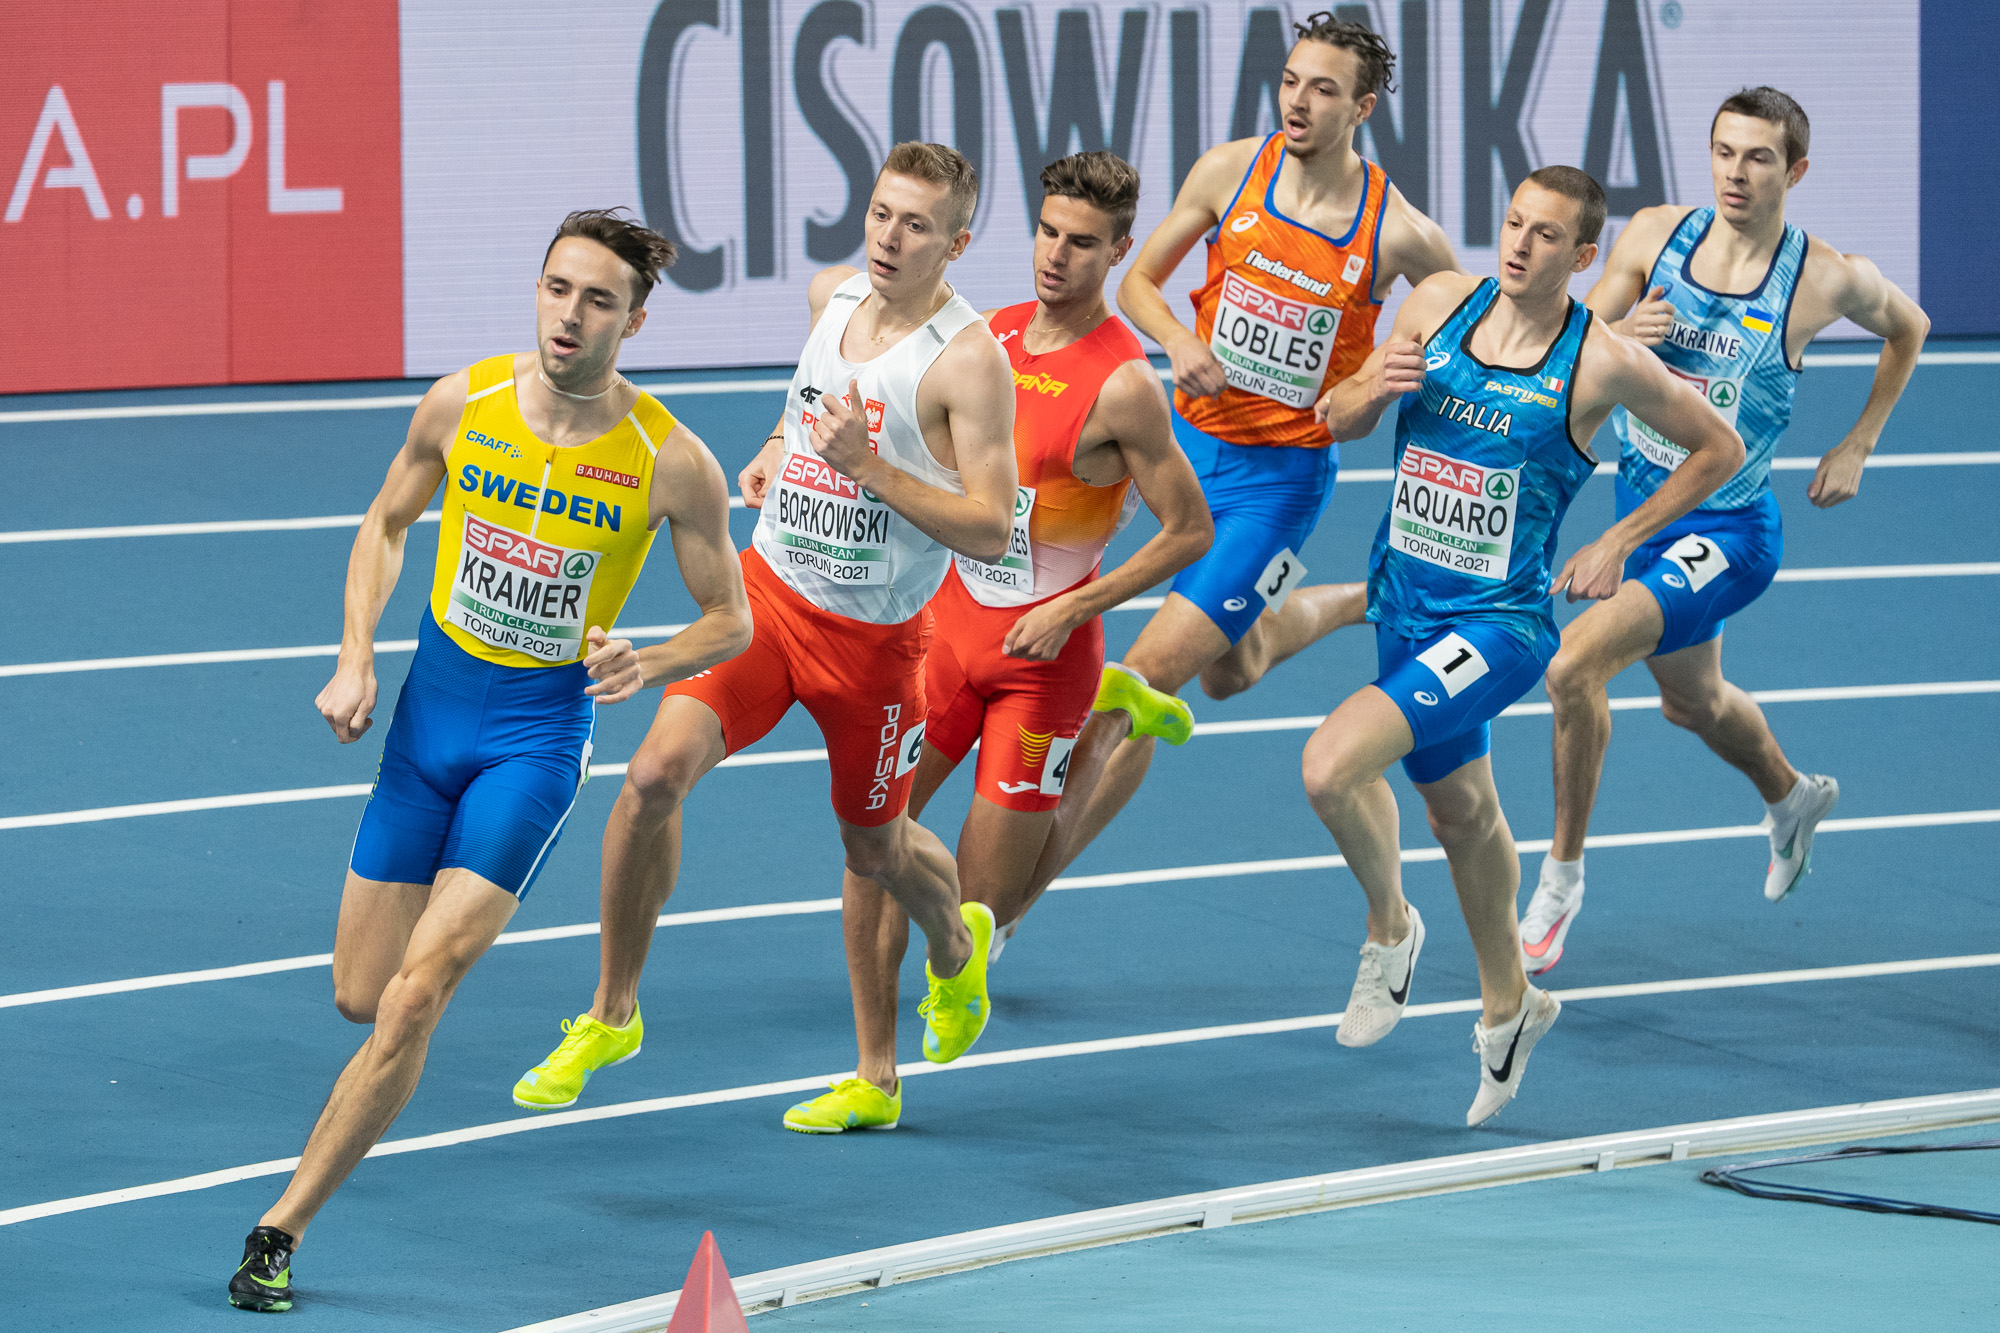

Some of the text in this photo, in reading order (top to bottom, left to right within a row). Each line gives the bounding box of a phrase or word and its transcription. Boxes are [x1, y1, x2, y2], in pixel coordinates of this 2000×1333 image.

[4, 80, 343, 222] A.PL
[1226, 279, 1304, 328] SPAR
[1218, 306, 1324, 372] LOBLES
[1230, 351, 1255, 370] RUN
[1222, 363, 1303, 403] ORUŃ 2021
[1437, 395, 1513, 437] ITALIA
[466, 430, 512, 454] CRAFT
[576, 464, 639, 488] BAUHAUS
[785, 457, 857, 496] SPAR
[1401, 450, 1481, 493] SPAR
[459, 464, 622, 532] SWEDEN
[780, 488, 890, 544] BORKOWSKI
[1396, 480, 1508, 538] AQUARO
[467, 522, 560, 574] SPAR
[798, 537, 819, 551] RUN
[1417, 525, 1440, 541] RUN
[785, 550, 869, 580] TORUŃ 2021
[1402, 535, 1490, 573] TORUŃ 2021
[1679, 541, 1710, 574] 2
[460, 550, 582, 620] KRAMER
[985, 568, 1017, 586] 2021
[1267, 560, 1290, 596] 3
[478, 603, 506, 623] RUN
[463, 612, 562, 657] TORUŃ 2021
[1442, 647, 1474, 675] 1
[865, 704, 901, 810] POLSKA
[907, 727, 925, 764] 6
[1052, 749, 1071, 787] 4
